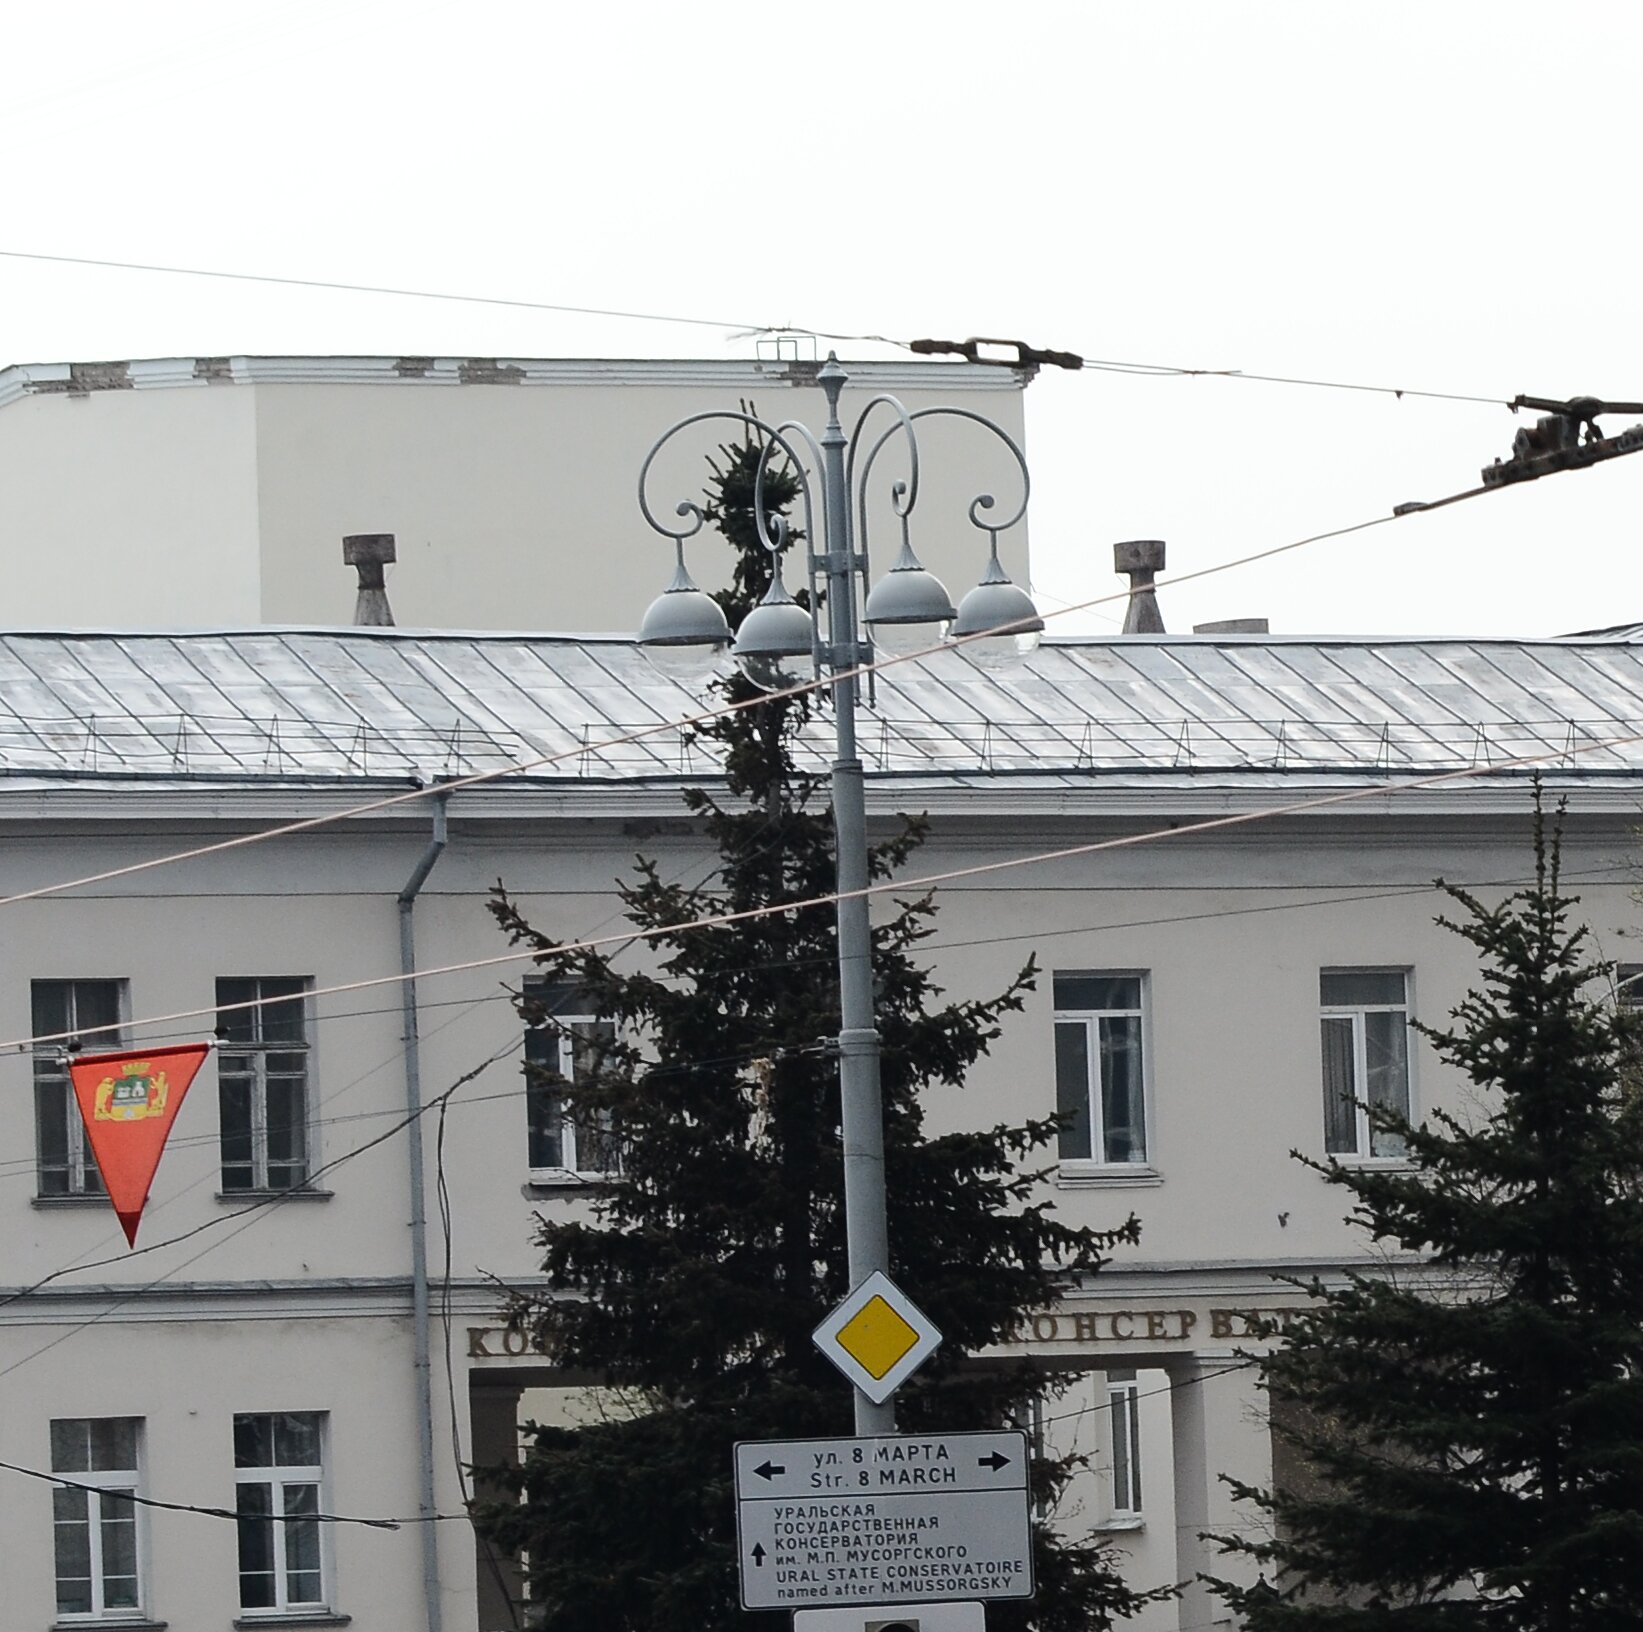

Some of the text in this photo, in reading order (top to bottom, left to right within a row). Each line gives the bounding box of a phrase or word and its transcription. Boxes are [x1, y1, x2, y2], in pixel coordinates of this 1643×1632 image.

[813, 1444, 949, 1469] ул. 8 МАРТА
[810, 1467, 957, 1488] Str. 8 MARCH
[774, 1504, 876, 1519] УРАЛЬСКАЯ
[774, 1517, 939, 1535] ГОСУДАРСТВЕННАЯ
[775, 1533, 919, 1550] КОНСЕРВАТОРИЯ
[776, 1546, 968, 1566] им. М.П. МУСОРГСКОГО
[776, 1560, 1023, 1583] URAL STATE CONSERVATOIRE
[777, 1576, 1012, 1598] named after M.MUSSORGSKY
